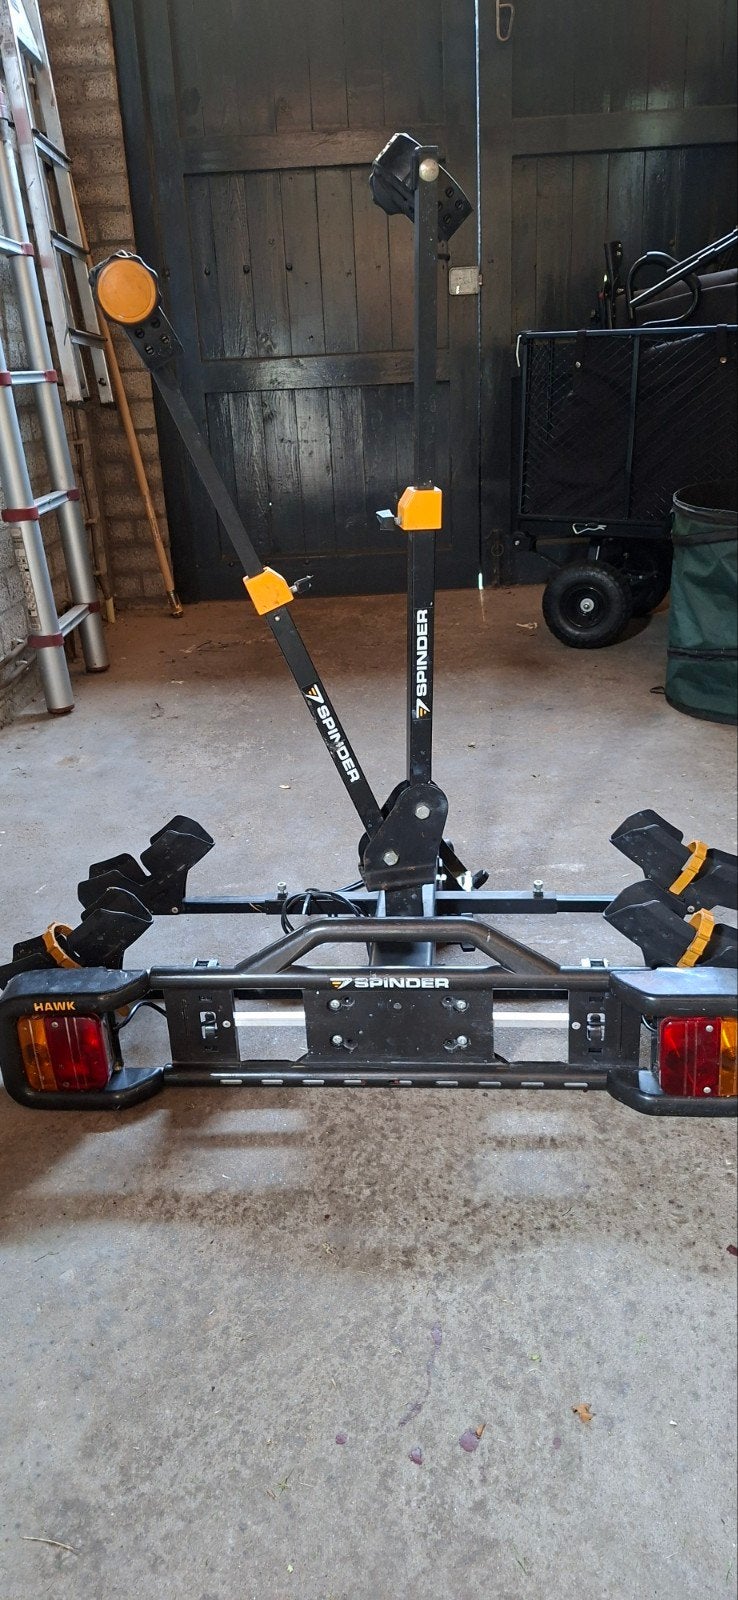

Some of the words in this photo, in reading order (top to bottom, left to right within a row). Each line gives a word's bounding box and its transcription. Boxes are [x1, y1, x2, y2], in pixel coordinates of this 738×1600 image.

[416, 609, 428, 697] SPINDER
[317, 704, 361, 783] SPINDER
[354, 977, 450, 989] SPINDER
[33, 1001, 77, 1012] HAWK
